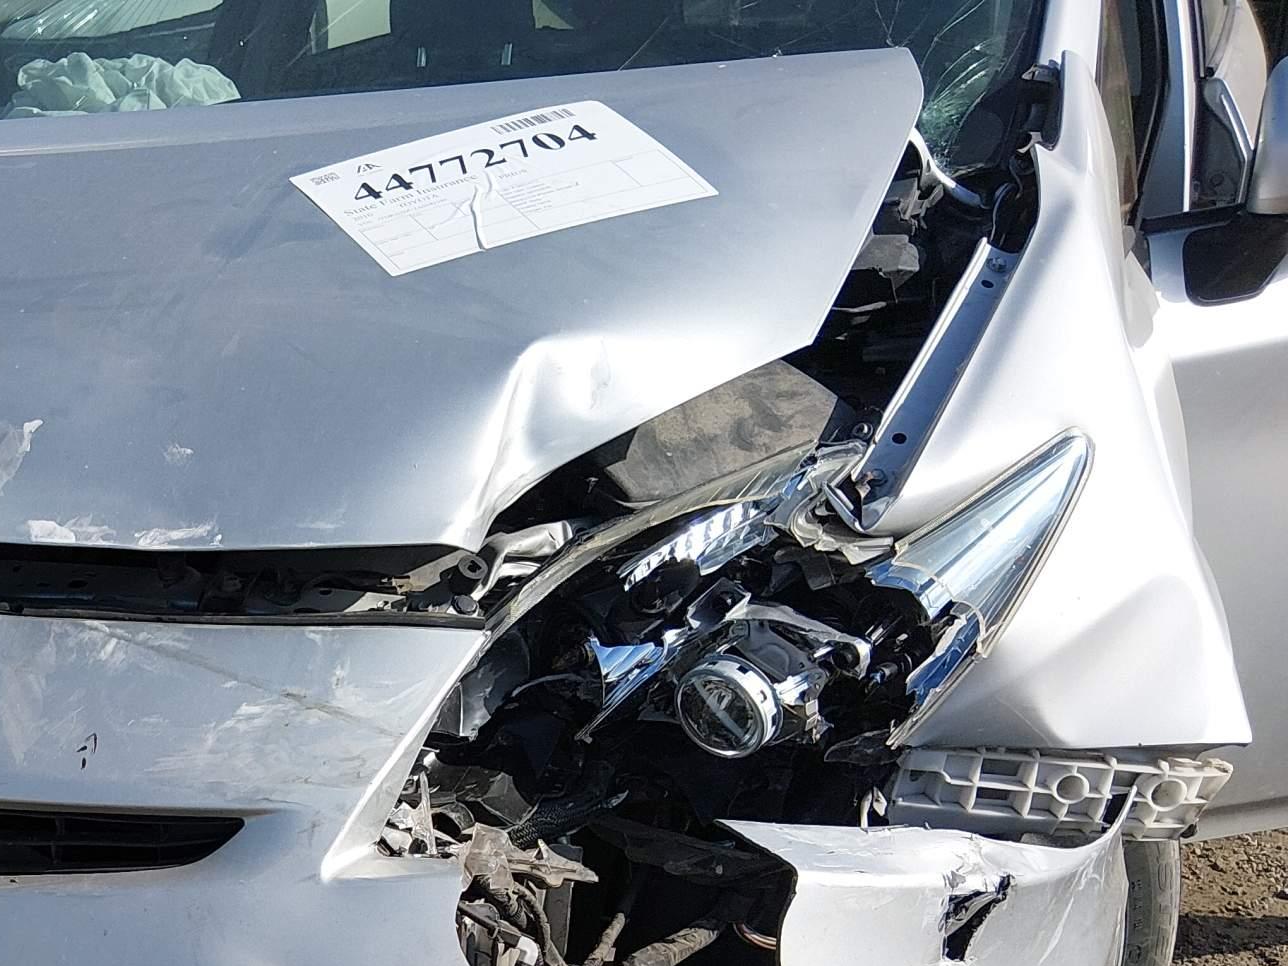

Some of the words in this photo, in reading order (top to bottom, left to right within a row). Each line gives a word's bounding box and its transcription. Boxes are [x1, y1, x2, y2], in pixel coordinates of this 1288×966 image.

[354, 123, 598, 200] 44772704
[344, 203, 377, 216] State
[379, 193, 414, 207] Farm
[416, 175, 479, 195] Insurance
[398, 194, 439, 208] TOYOTA
